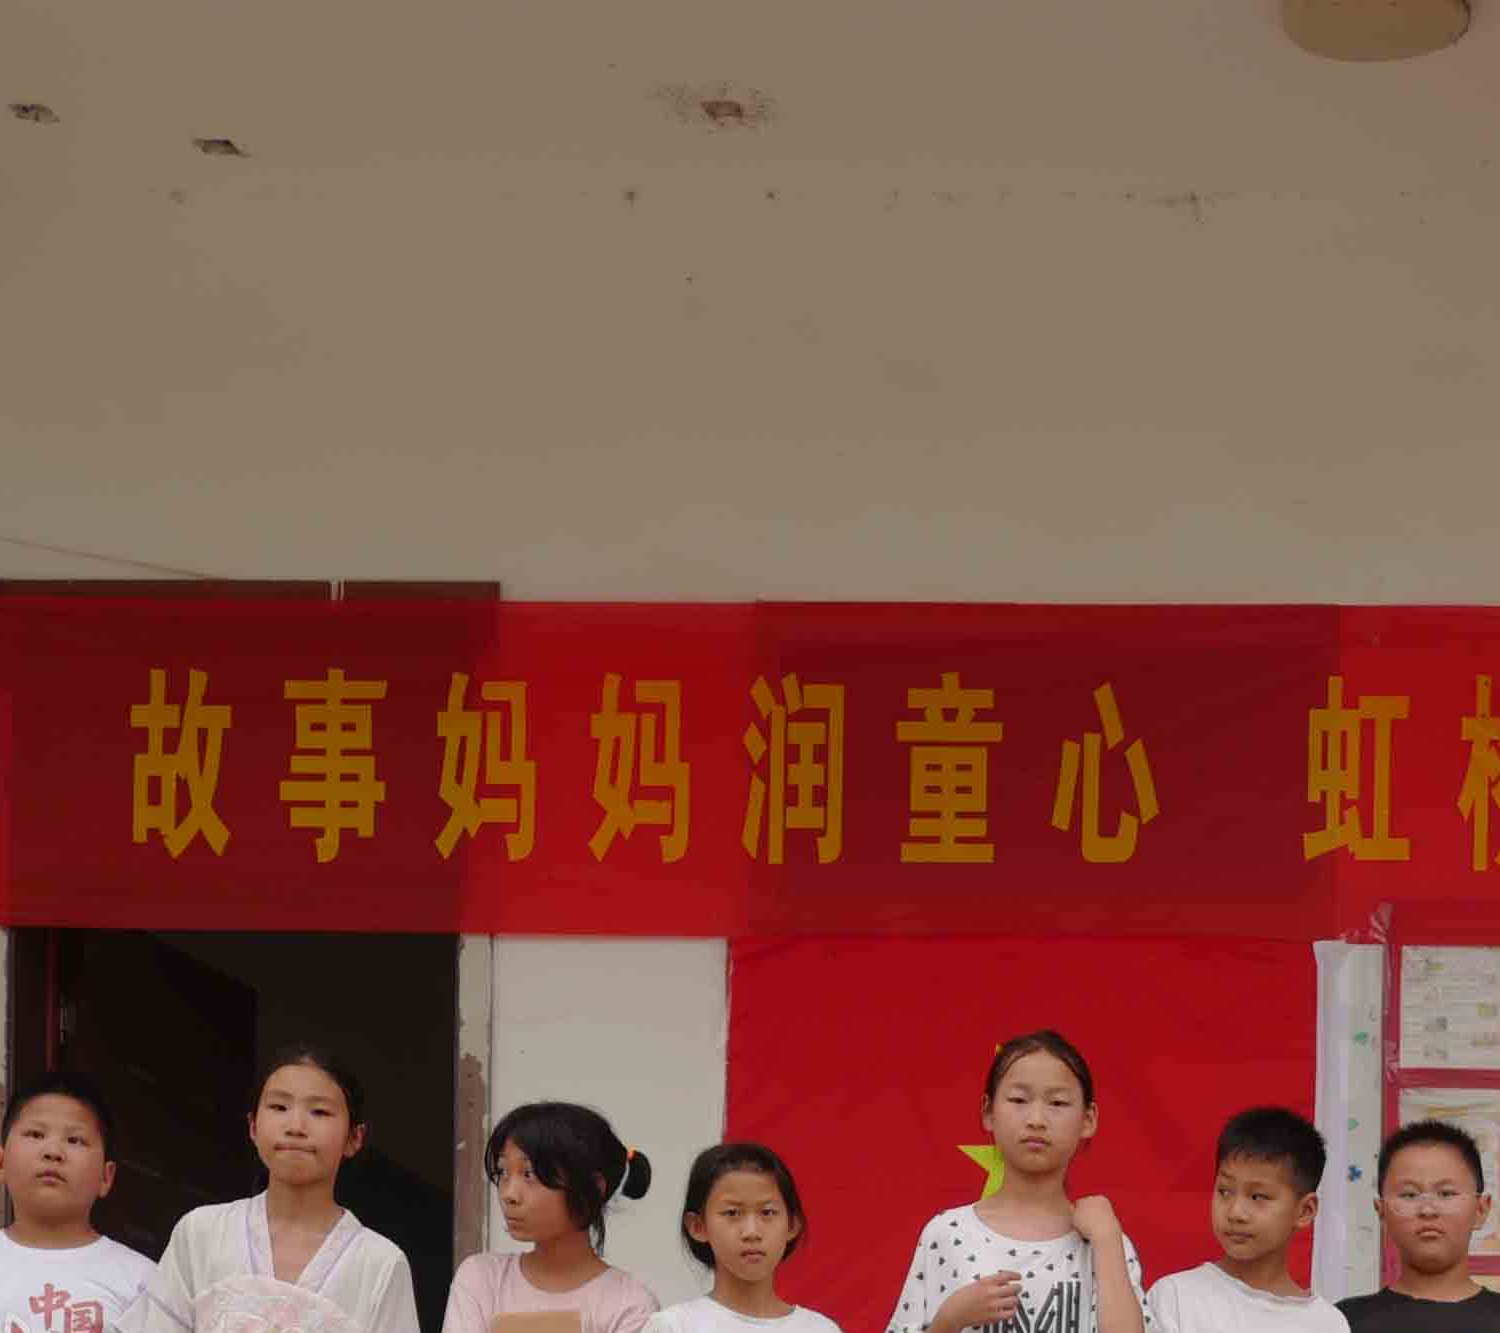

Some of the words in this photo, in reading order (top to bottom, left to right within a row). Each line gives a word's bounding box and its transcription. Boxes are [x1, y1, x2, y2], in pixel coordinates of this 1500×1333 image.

[130, 668, 1159, 865] 故事妈妈润童心
